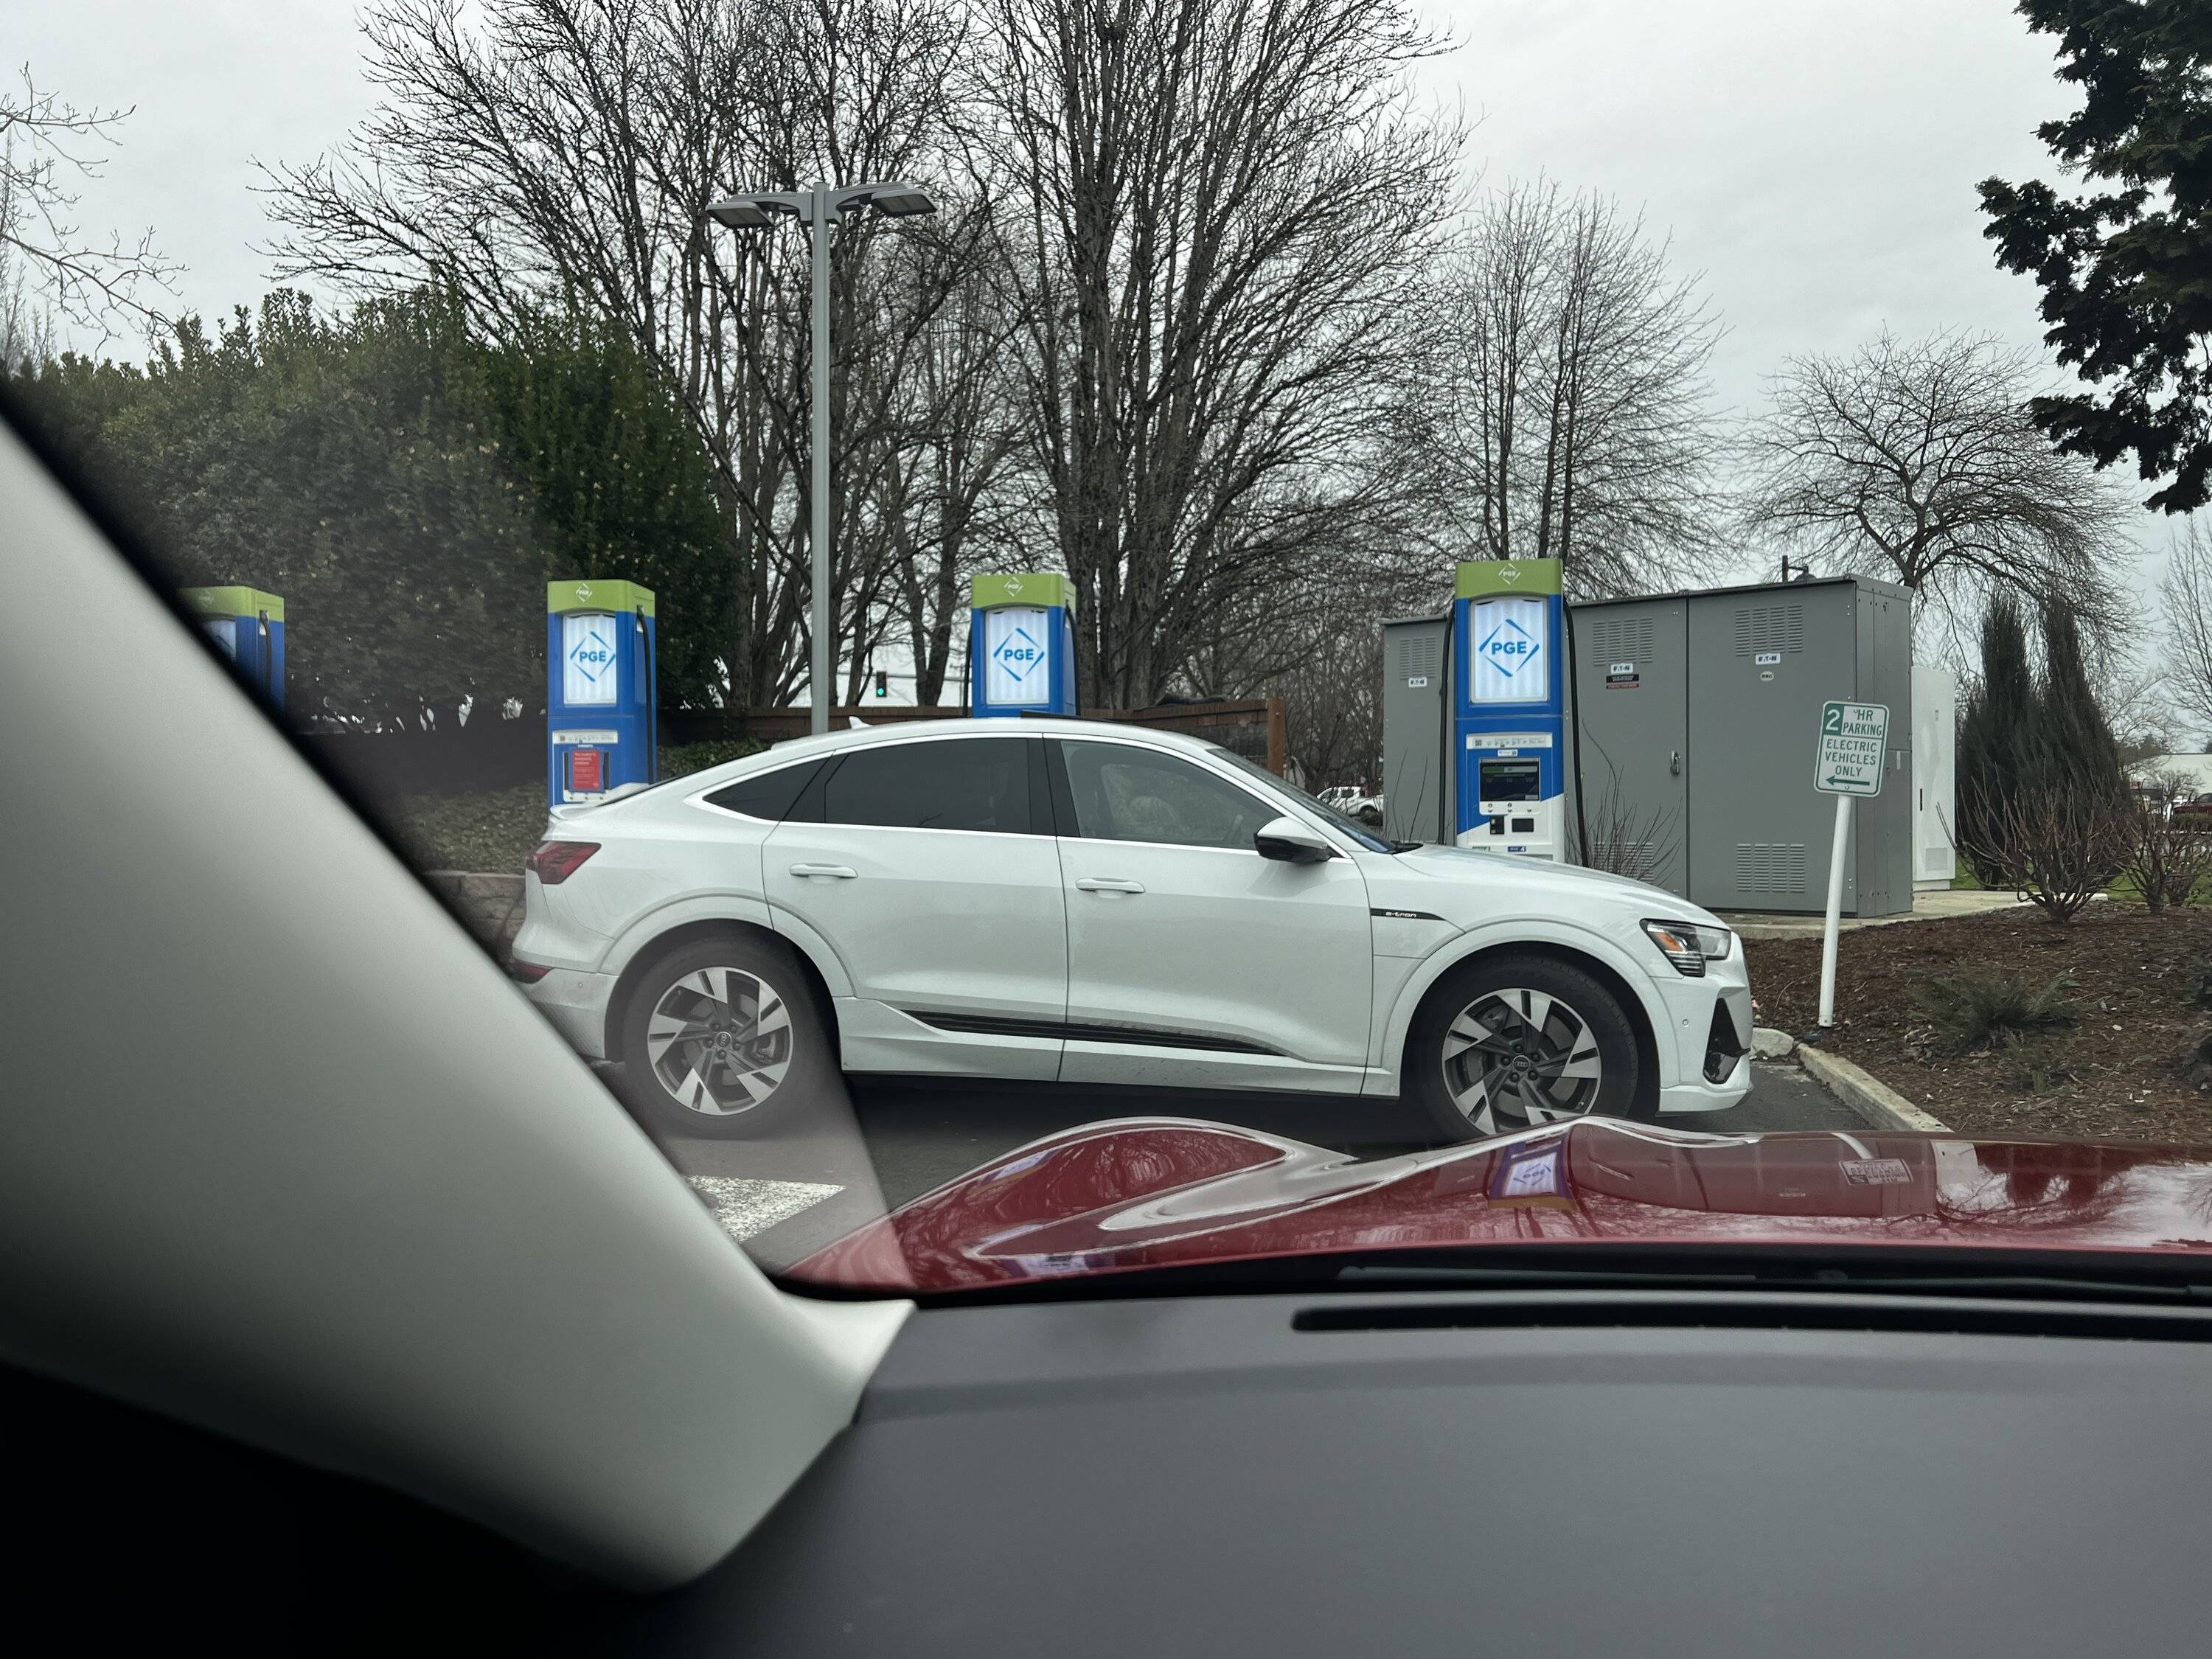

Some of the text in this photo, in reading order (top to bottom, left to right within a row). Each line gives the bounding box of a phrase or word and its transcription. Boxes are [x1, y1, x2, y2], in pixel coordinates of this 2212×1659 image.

[1492, 641, 1527, 655] PGE
[579, 651, 606, 662] PGE
[1004, 649, 1034, 661] PGE
[1825, 709, 1874, 731] 2 HR
[1843, 722, 1882, 736] PARKING
[1826, 739, 1877, 752] ELECTRIC
[1825, 751, 1877, 765] VEHICLES
[1835, 765, 1863, 777] ONLY
